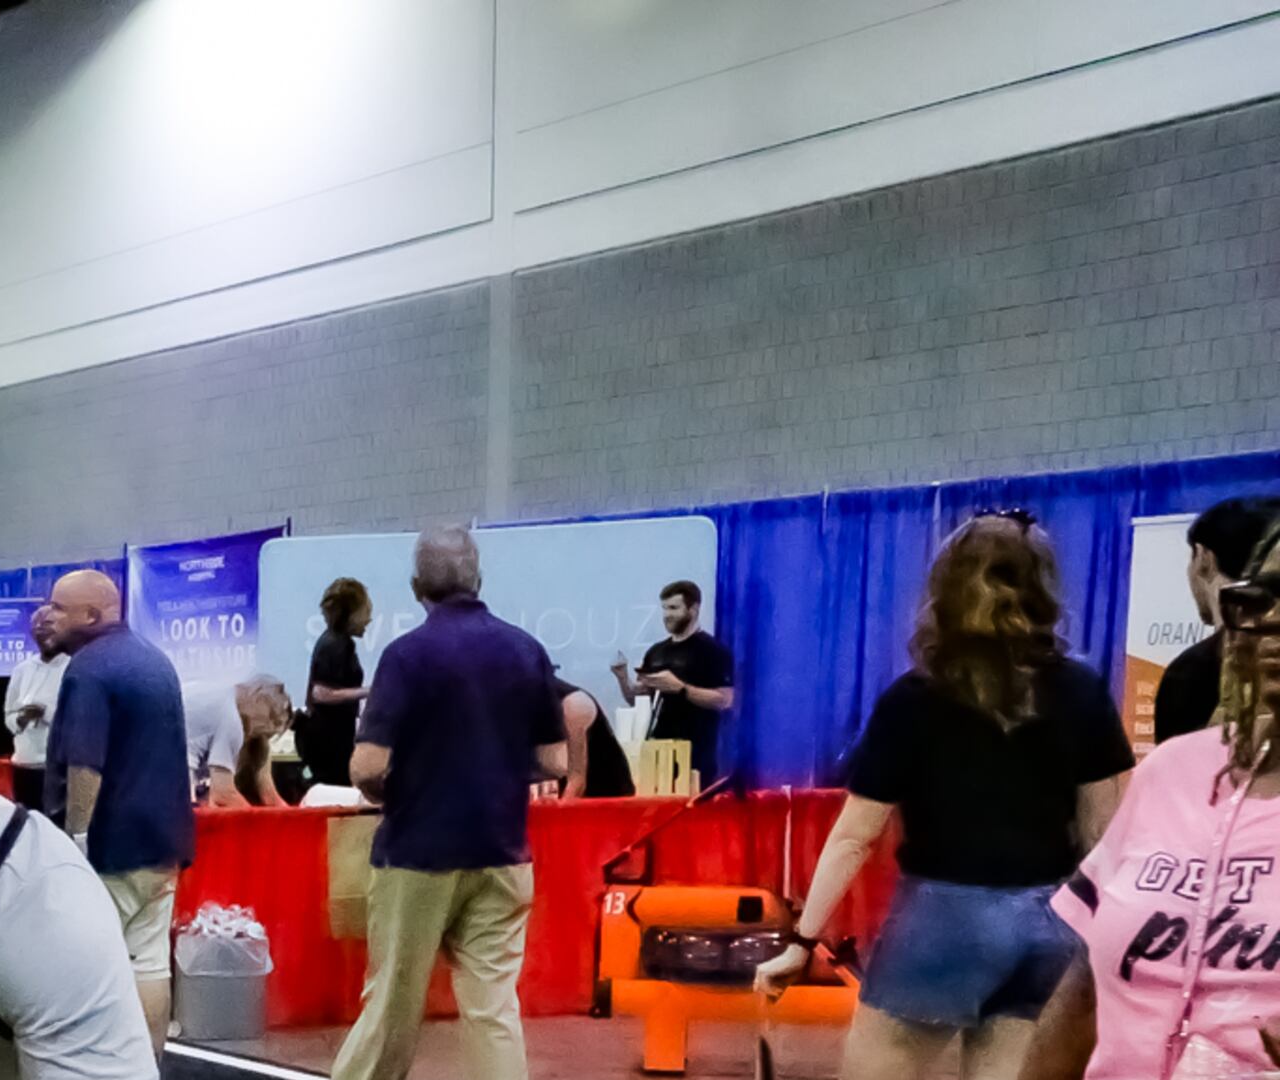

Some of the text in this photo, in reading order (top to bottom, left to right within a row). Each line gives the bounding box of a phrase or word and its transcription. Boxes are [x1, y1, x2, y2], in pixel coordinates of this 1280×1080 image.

[161, 613, 244, 641] LOOK TO
[7, 640, 25, 650] TO
[1135, 852, 1275, 904] GET
[604, 892, 626, 915] 13
